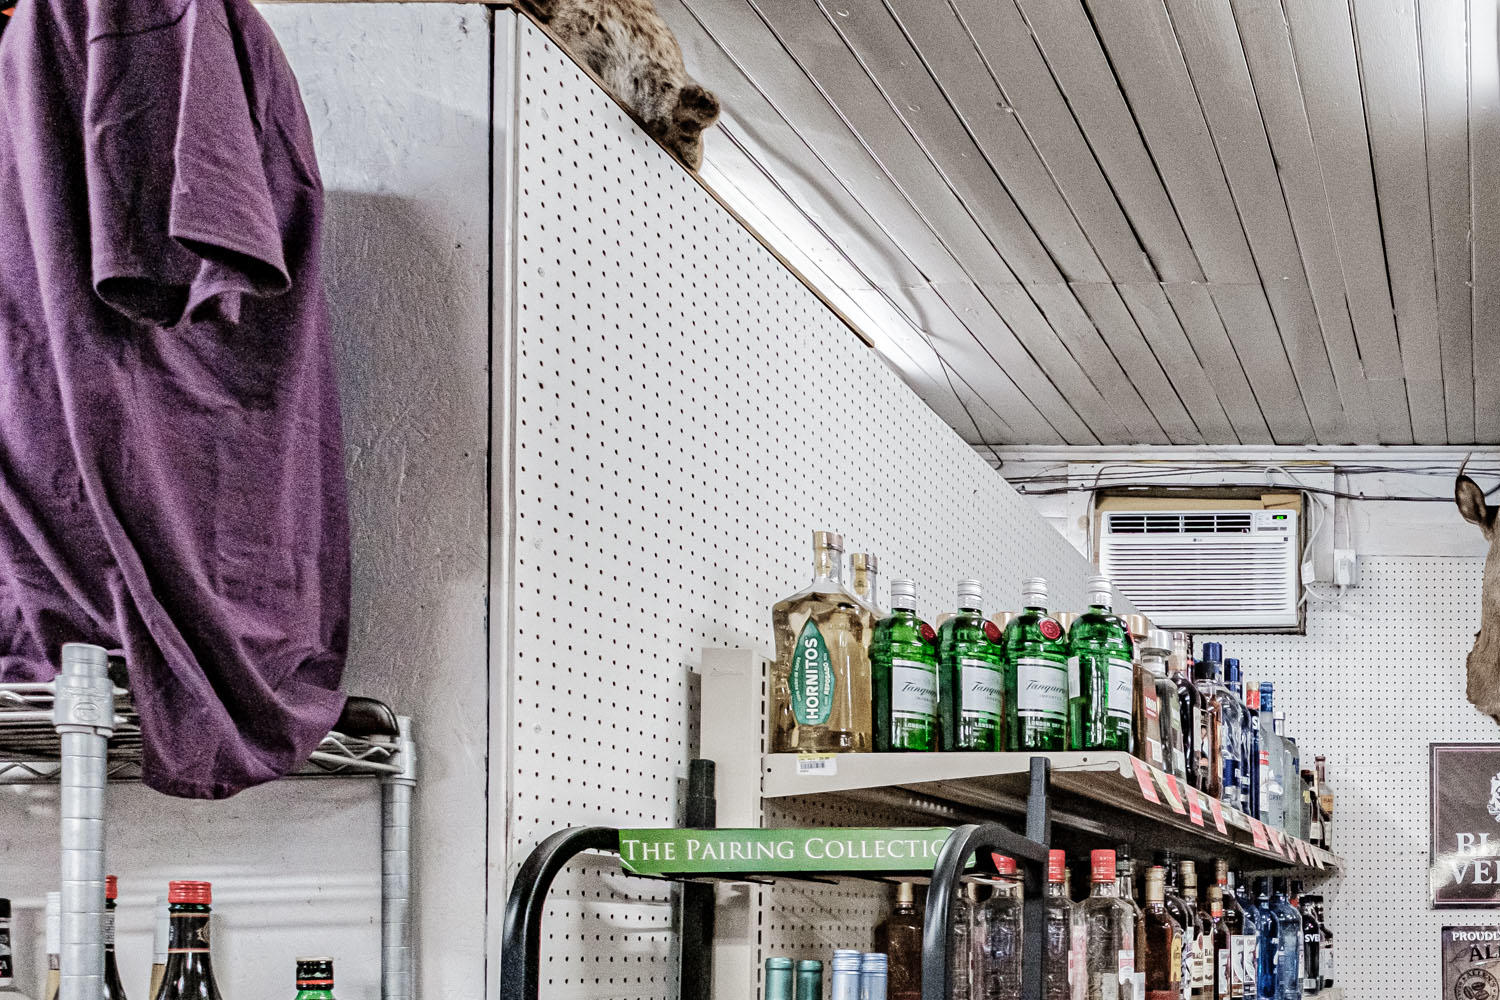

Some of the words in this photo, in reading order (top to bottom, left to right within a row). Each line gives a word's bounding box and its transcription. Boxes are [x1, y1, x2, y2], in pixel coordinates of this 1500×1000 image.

[805, 638, 819, 720] HORNITOS
[622, 839, 676, 861] THE
[687, 838, 795, 860] PAIRING
